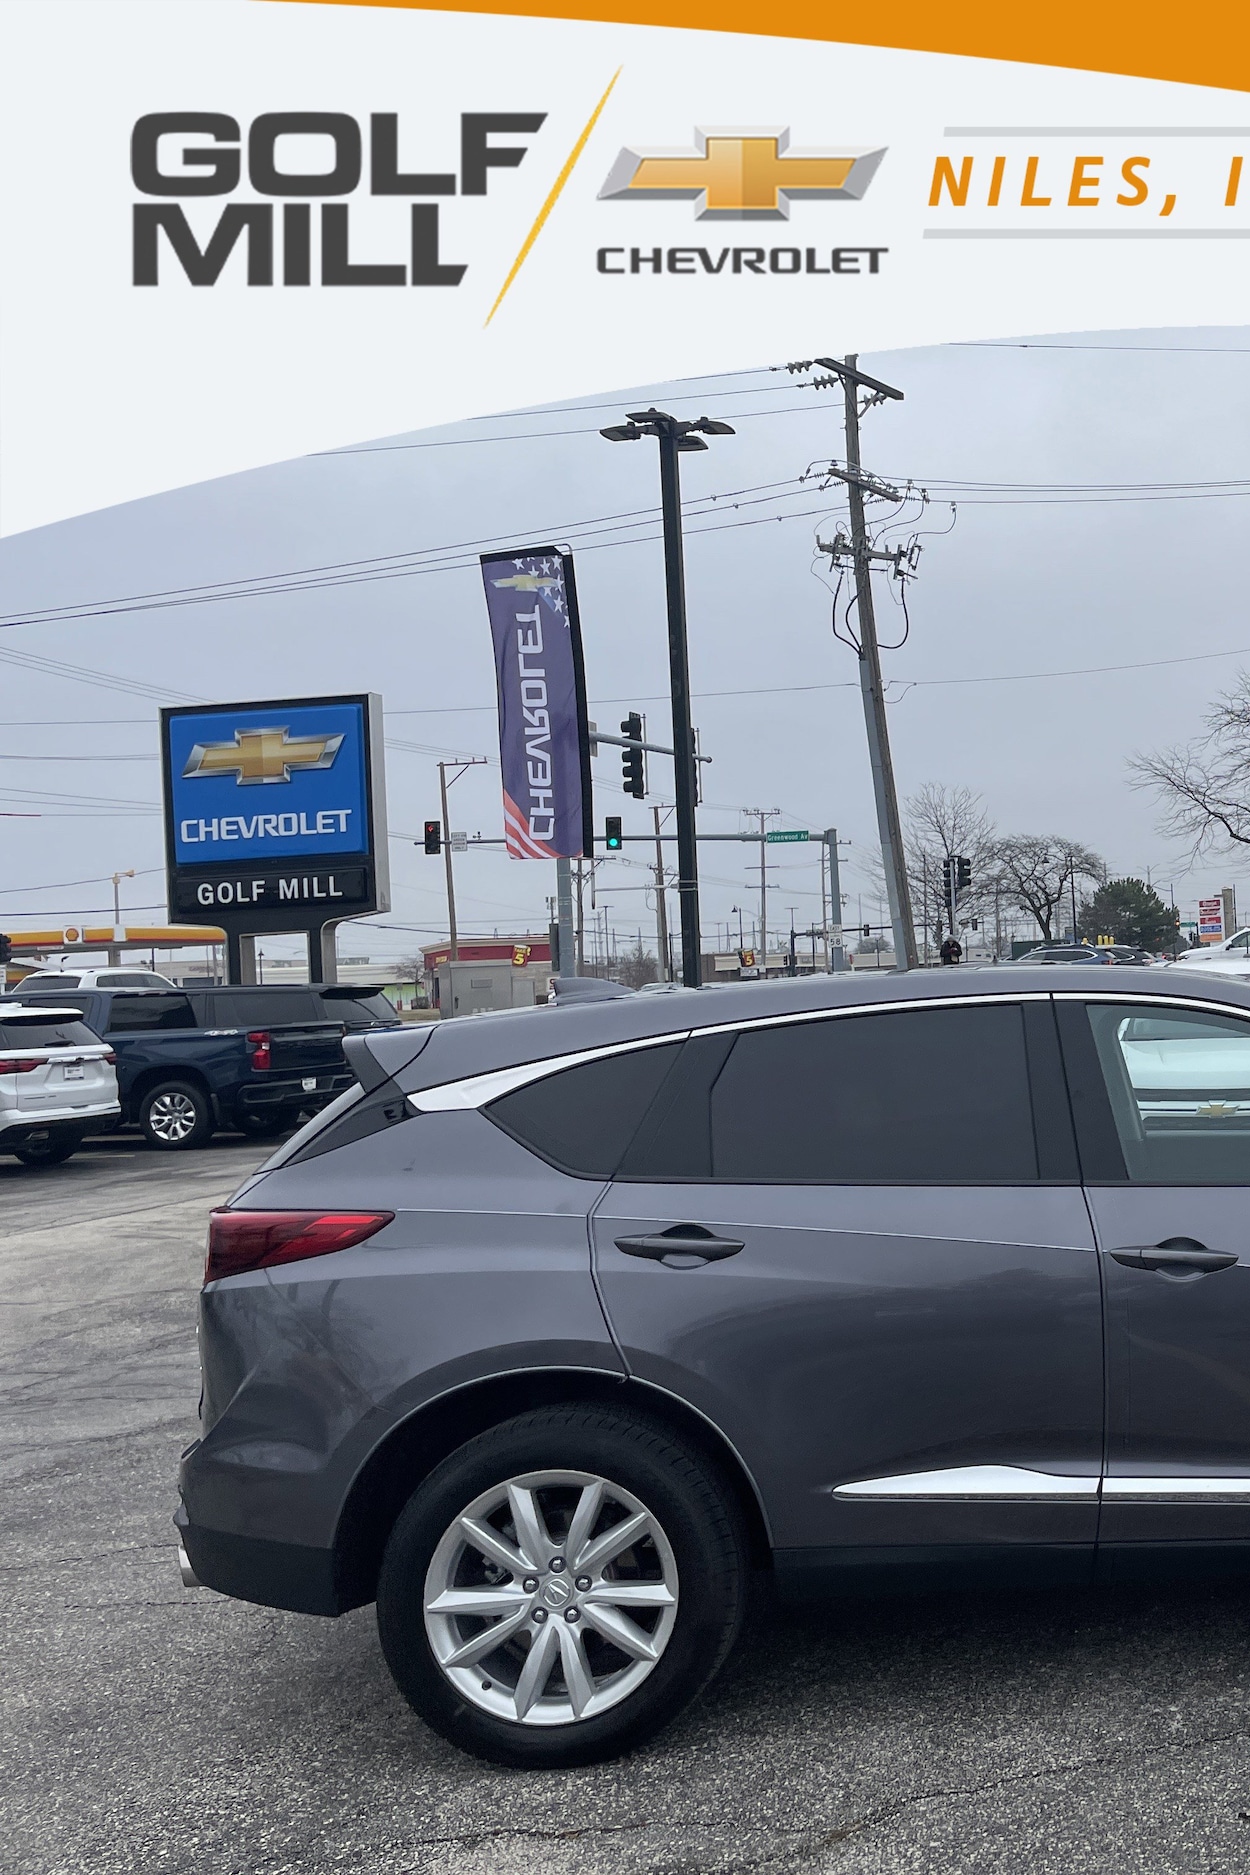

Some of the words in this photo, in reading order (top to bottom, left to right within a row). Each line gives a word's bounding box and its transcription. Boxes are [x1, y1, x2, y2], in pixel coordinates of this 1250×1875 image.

[180, 809, 352, 843] CHEVROLET
[767, 833, 798, 841] Greenwood
[197, 880, 266, 906] GOLF
[278, 875, 343, 900] MILL
[830, 938, 841, 946] 58
[513, 953, 525, 965] 5
[745, 956, 753, 966] 5
